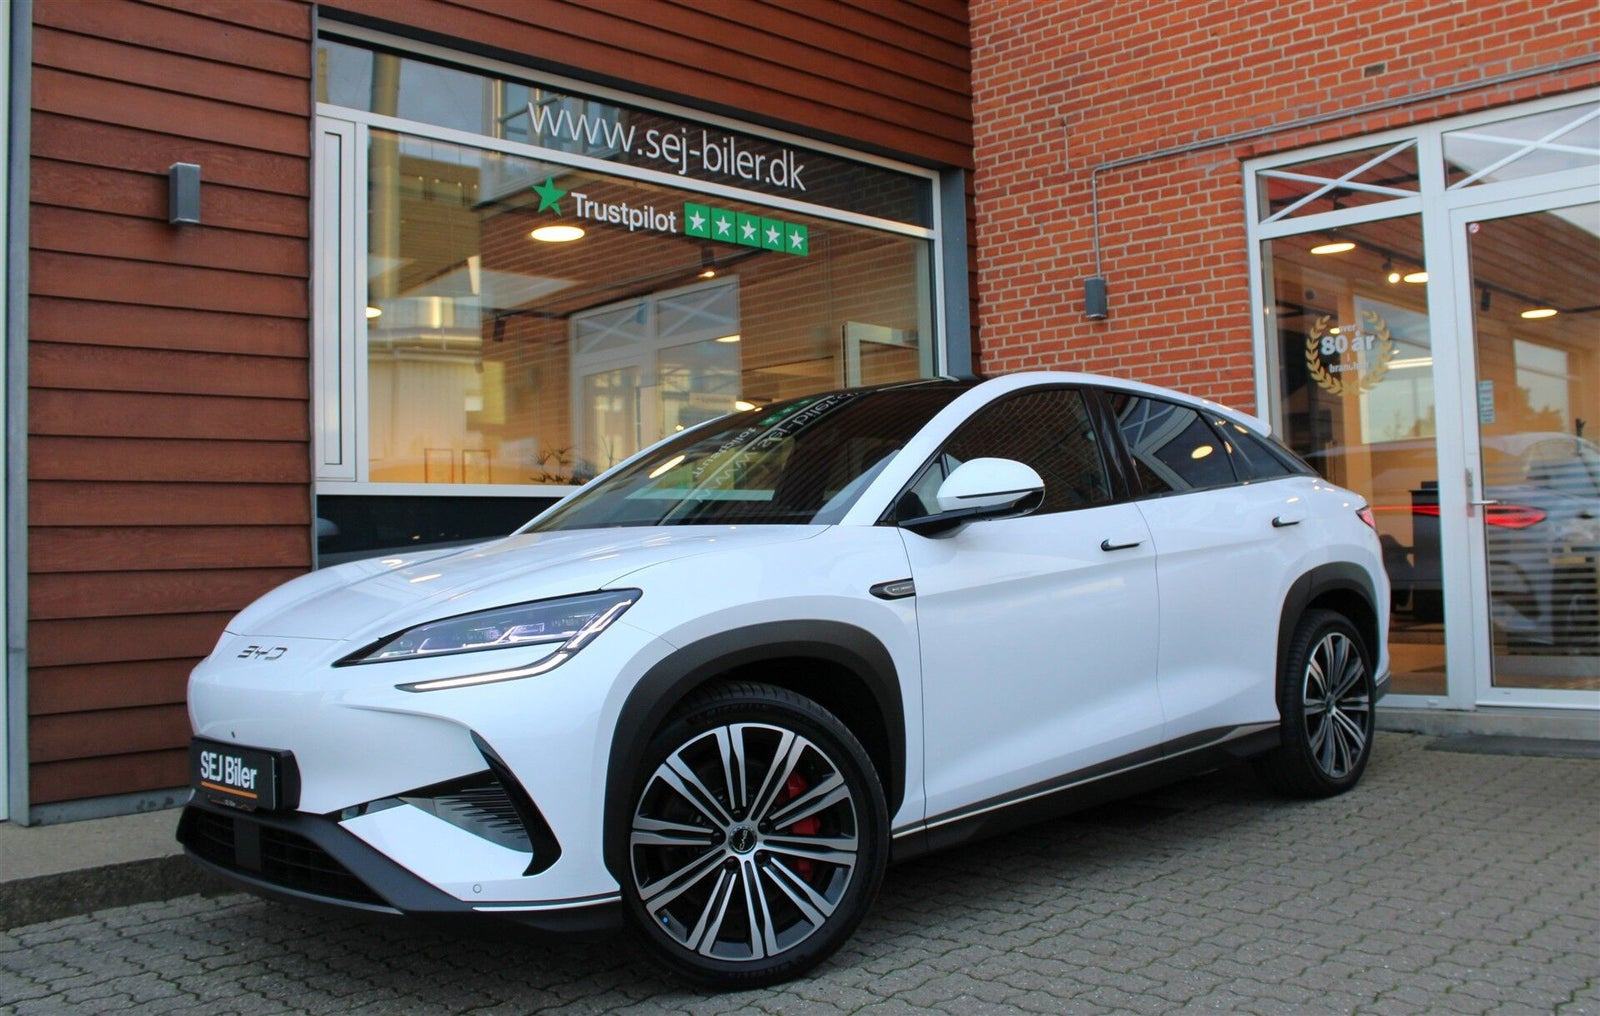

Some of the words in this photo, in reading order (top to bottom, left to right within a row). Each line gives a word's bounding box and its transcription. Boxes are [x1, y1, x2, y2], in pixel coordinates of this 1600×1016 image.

[527, 101, 806, 192] www.sej-biler.dk
[571, 191, 677, 233] Trustpilot
[1321, 335, 1347, 355] 80
[1352, 330, 1375, 352] år
[237, 645, 288, 661] BYD
[200, 750, 223, 782] SEJ
[225, 755, 257, 789] Biler
